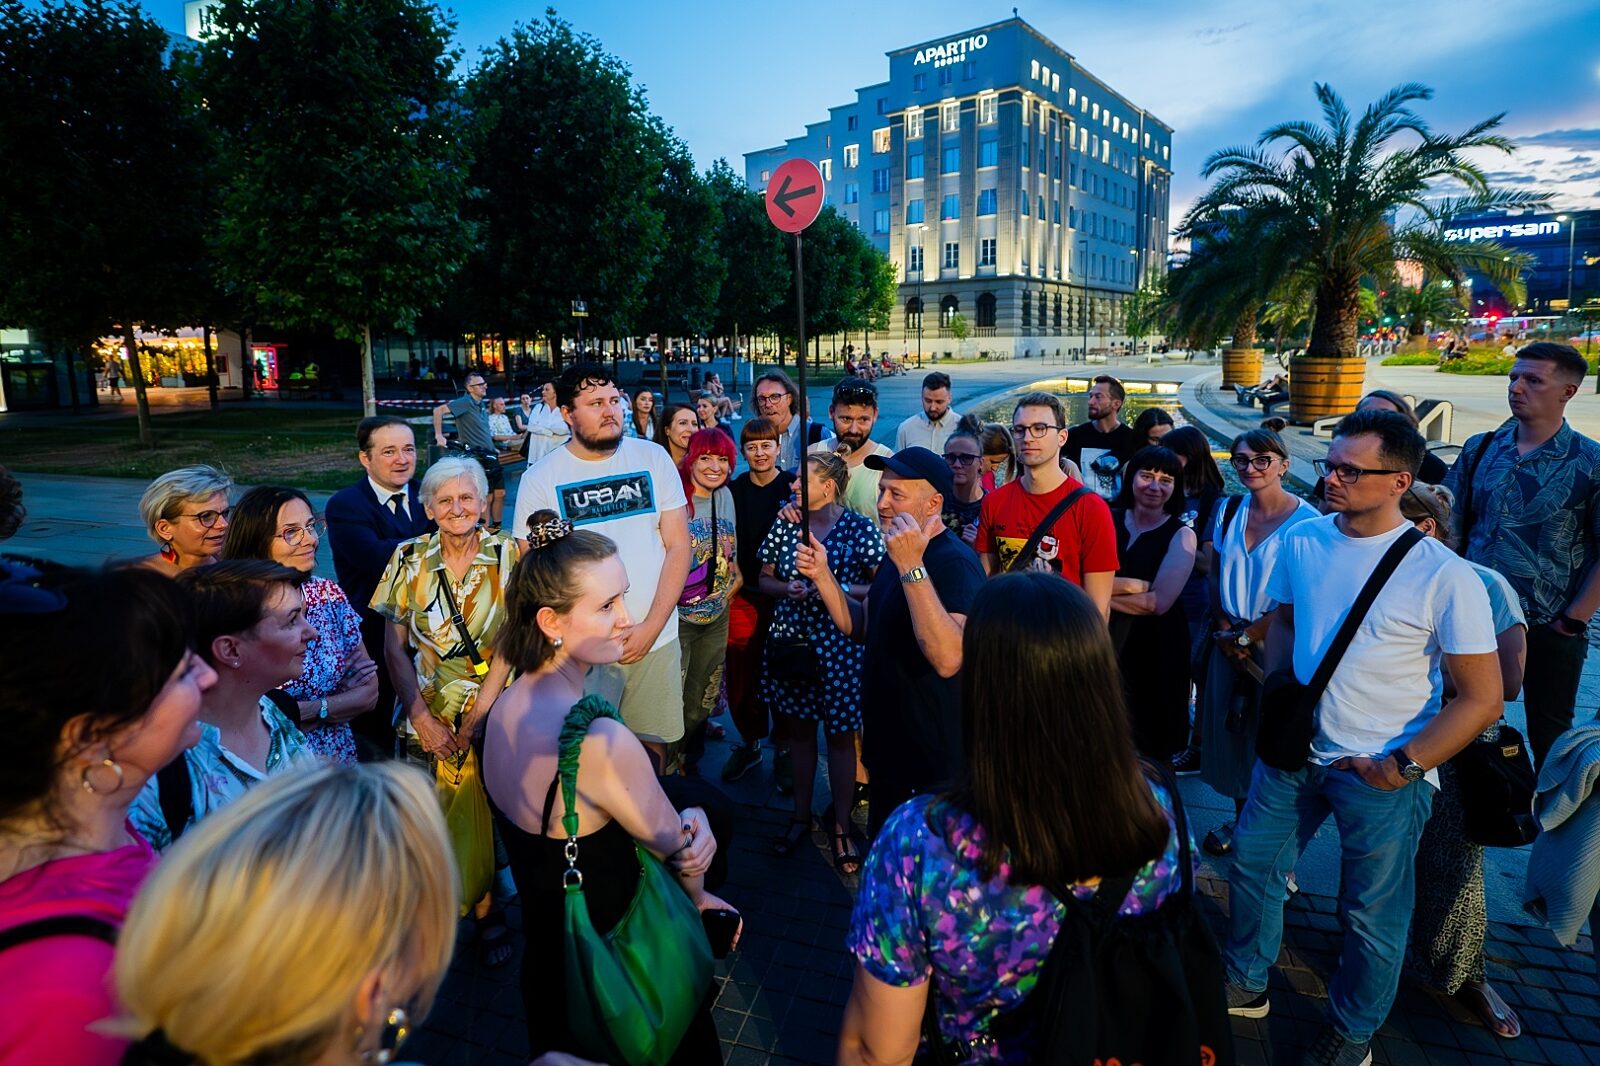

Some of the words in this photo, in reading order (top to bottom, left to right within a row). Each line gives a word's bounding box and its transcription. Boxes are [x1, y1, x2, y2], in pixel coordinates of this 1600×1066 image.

[913, 34, 988, 66] APARTIO
[1444, 221, 1560, 242] supersam
[573, 482, 643, 508] URBAN
